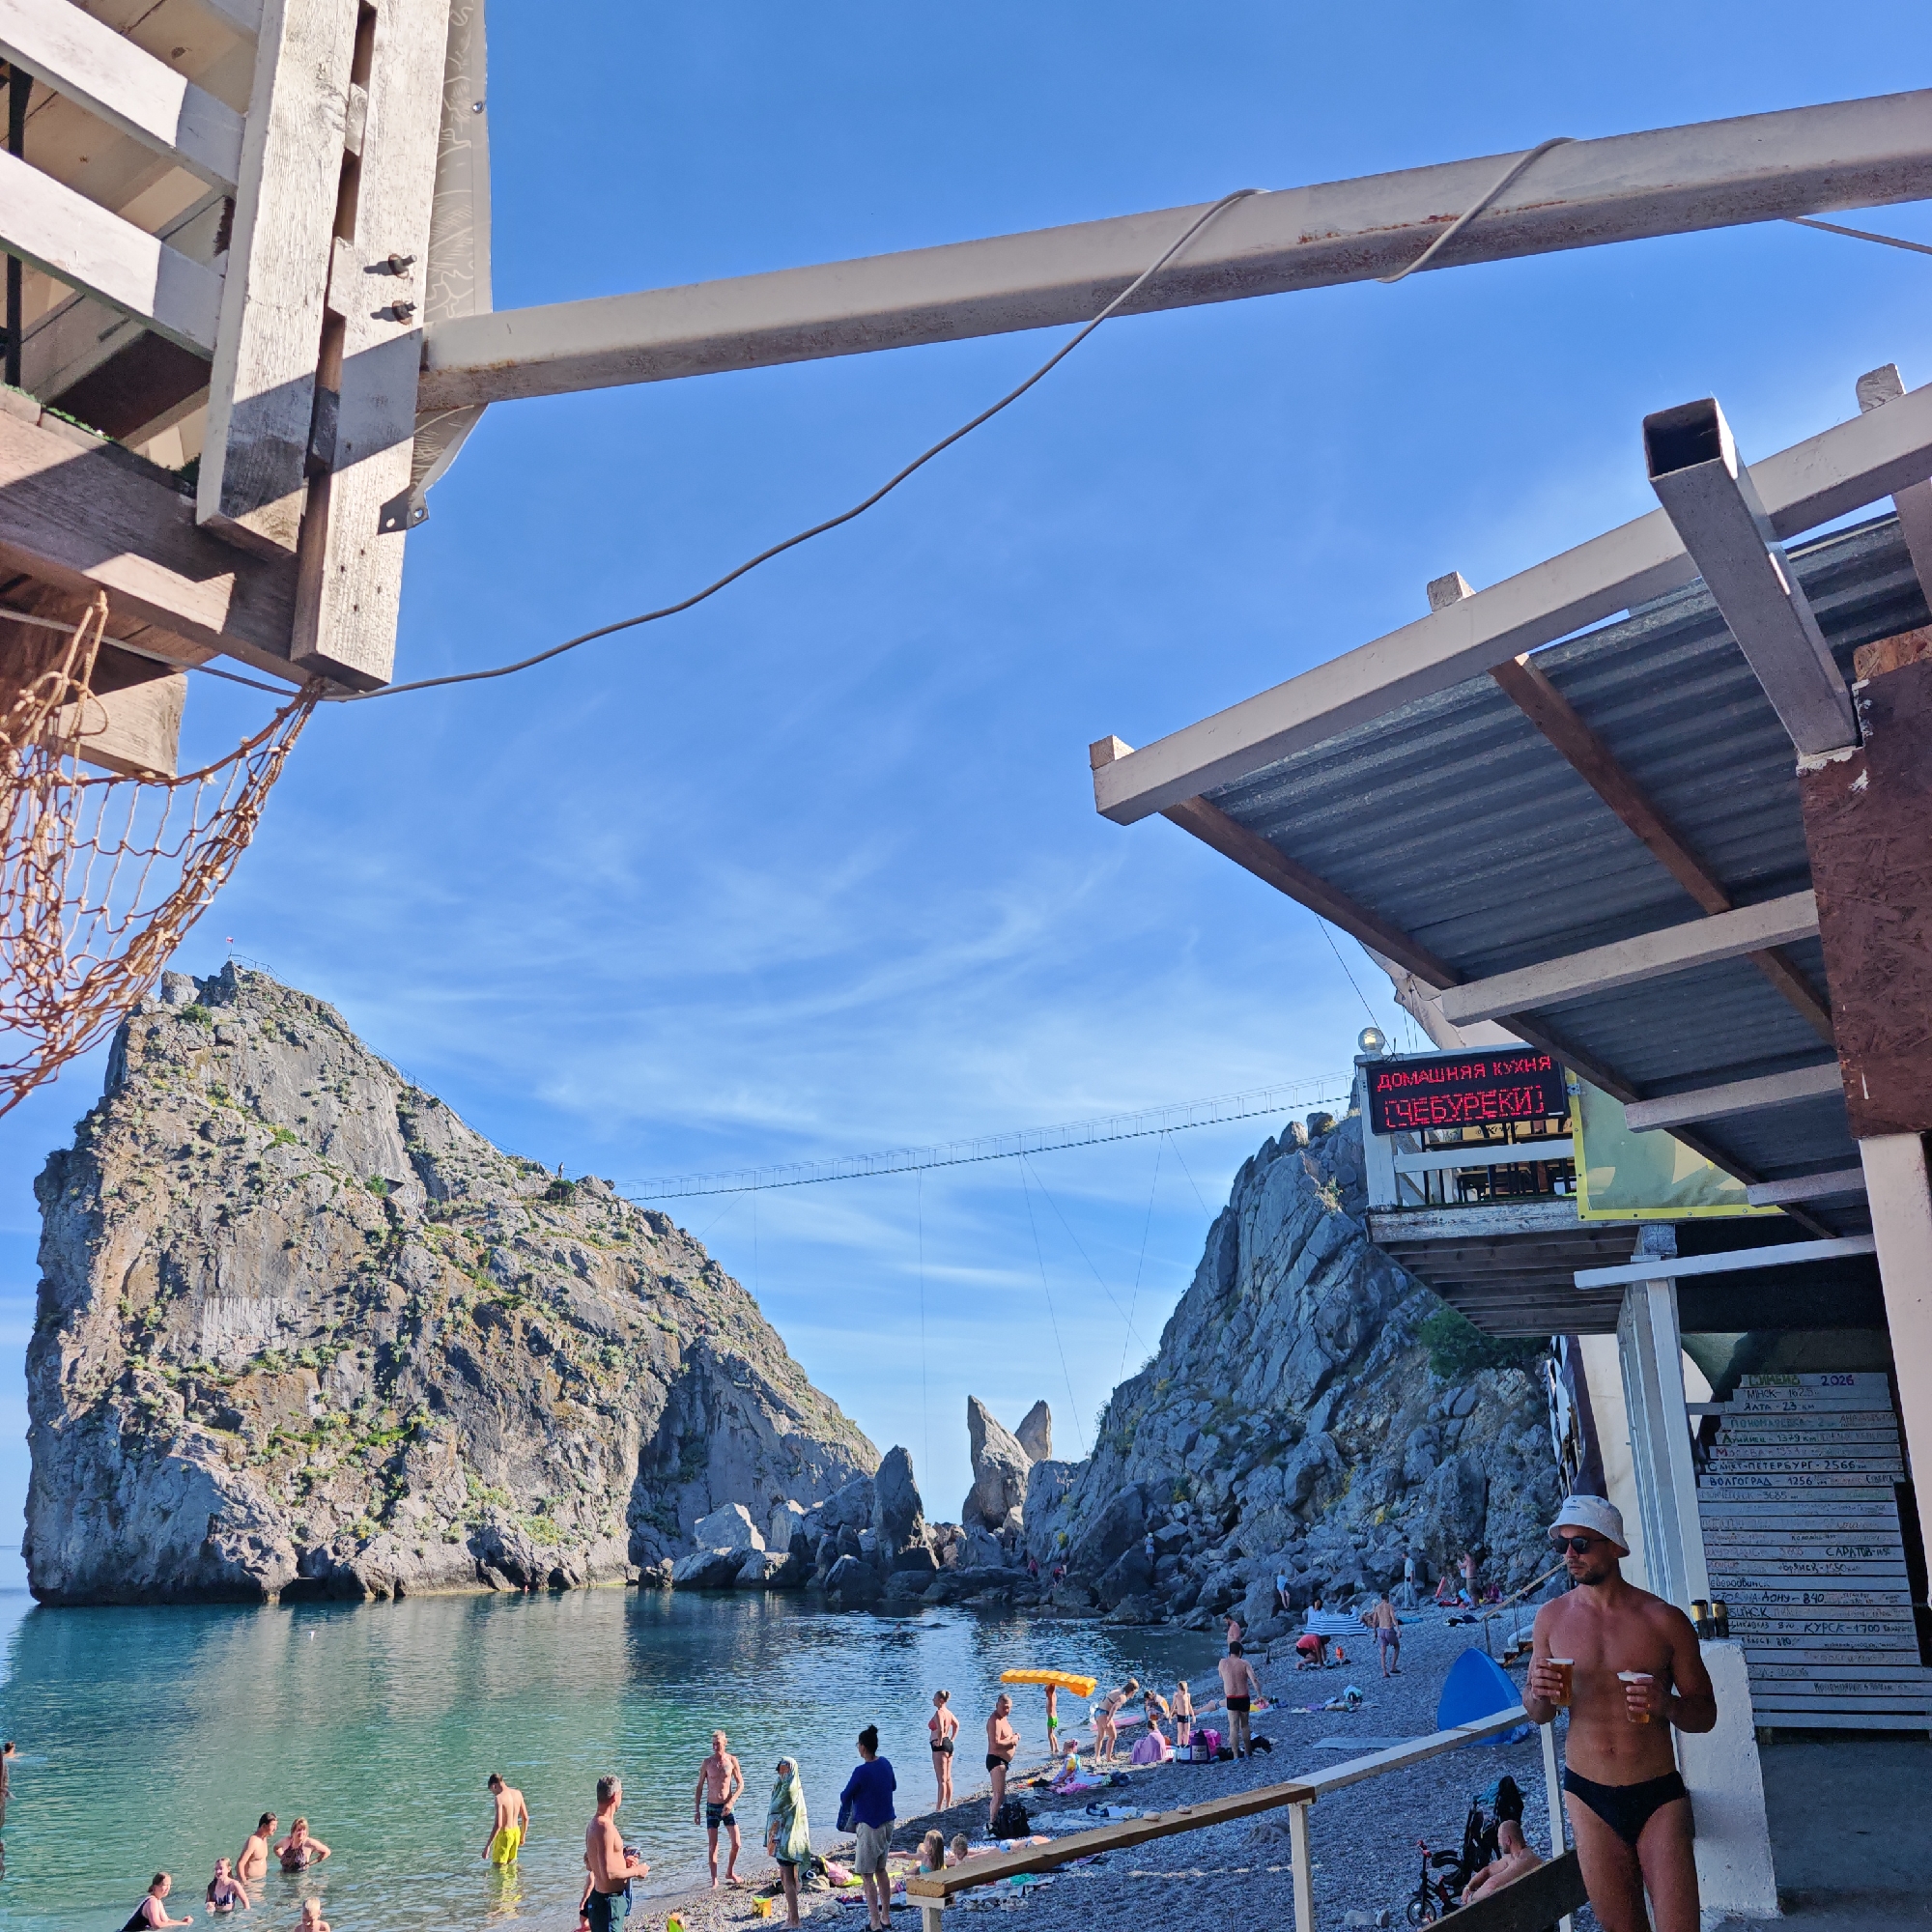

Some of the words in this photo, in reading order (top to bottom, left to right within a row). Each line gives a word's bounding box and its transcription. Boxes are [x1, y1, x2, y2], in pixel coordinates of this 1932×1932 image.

[1377, 1063, 1487, 1093] ДОМАШНЯЯ
[1492, 1055, 1551, 1076] КУХНЯ
[1396, 1089, 1532, 1123] ЧЕБУРЕКИ
[1821, 1374, 1855, 1387] 2026
[1743, 1402, 1773, 1411] ЯЛТА
[1782, 1401, 1798, 1411] 23
[1777, 1434, 1801, 1442] 1379
[1824, 1460, 1856, 1470] 2566
[1709, 1476, 1774, 1487] ВОЛГОГРАД
[1787, 1475, 1813, 1486] 1256
[1803, 1592, 1825, 1605] 840
